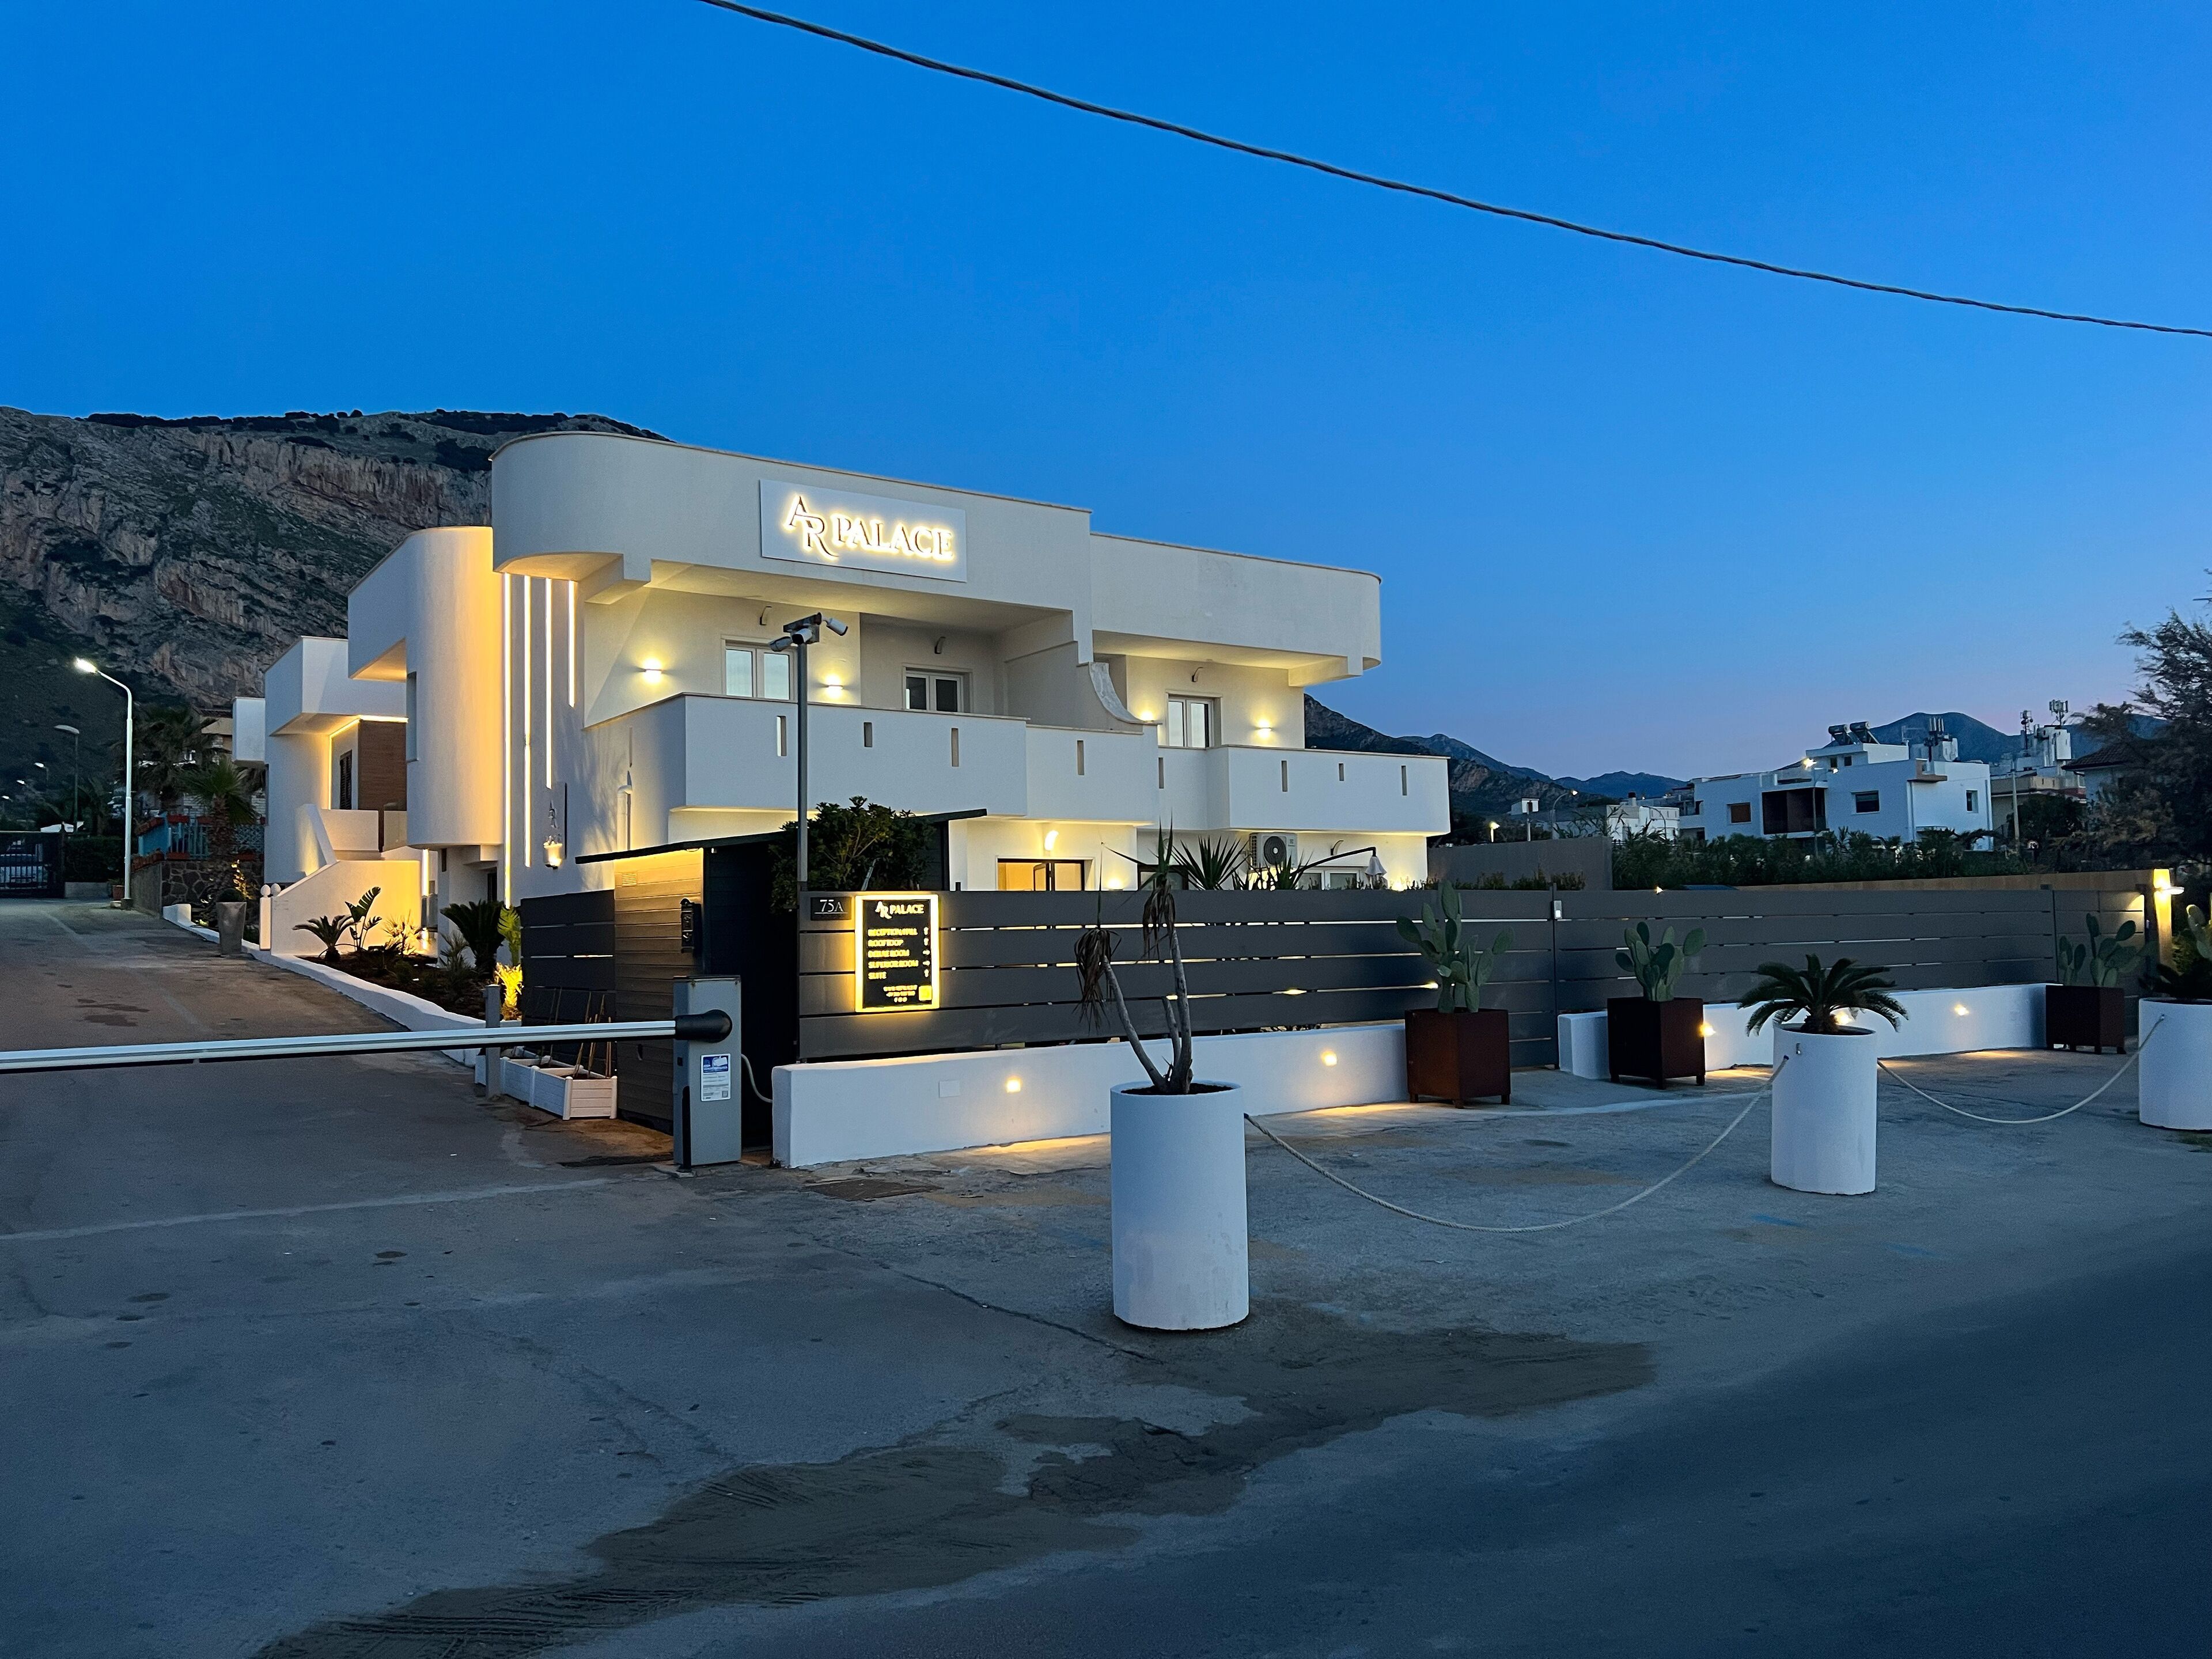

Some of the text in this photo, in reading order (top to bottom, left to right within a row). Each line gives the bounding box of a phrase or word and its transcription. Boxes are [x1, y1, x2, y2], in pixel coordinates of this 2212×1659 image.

[786, 495, 953, 558] AR PALACE
[820, 899, 844, 912] 75A
[889, 904, 925, 915] PALACE
